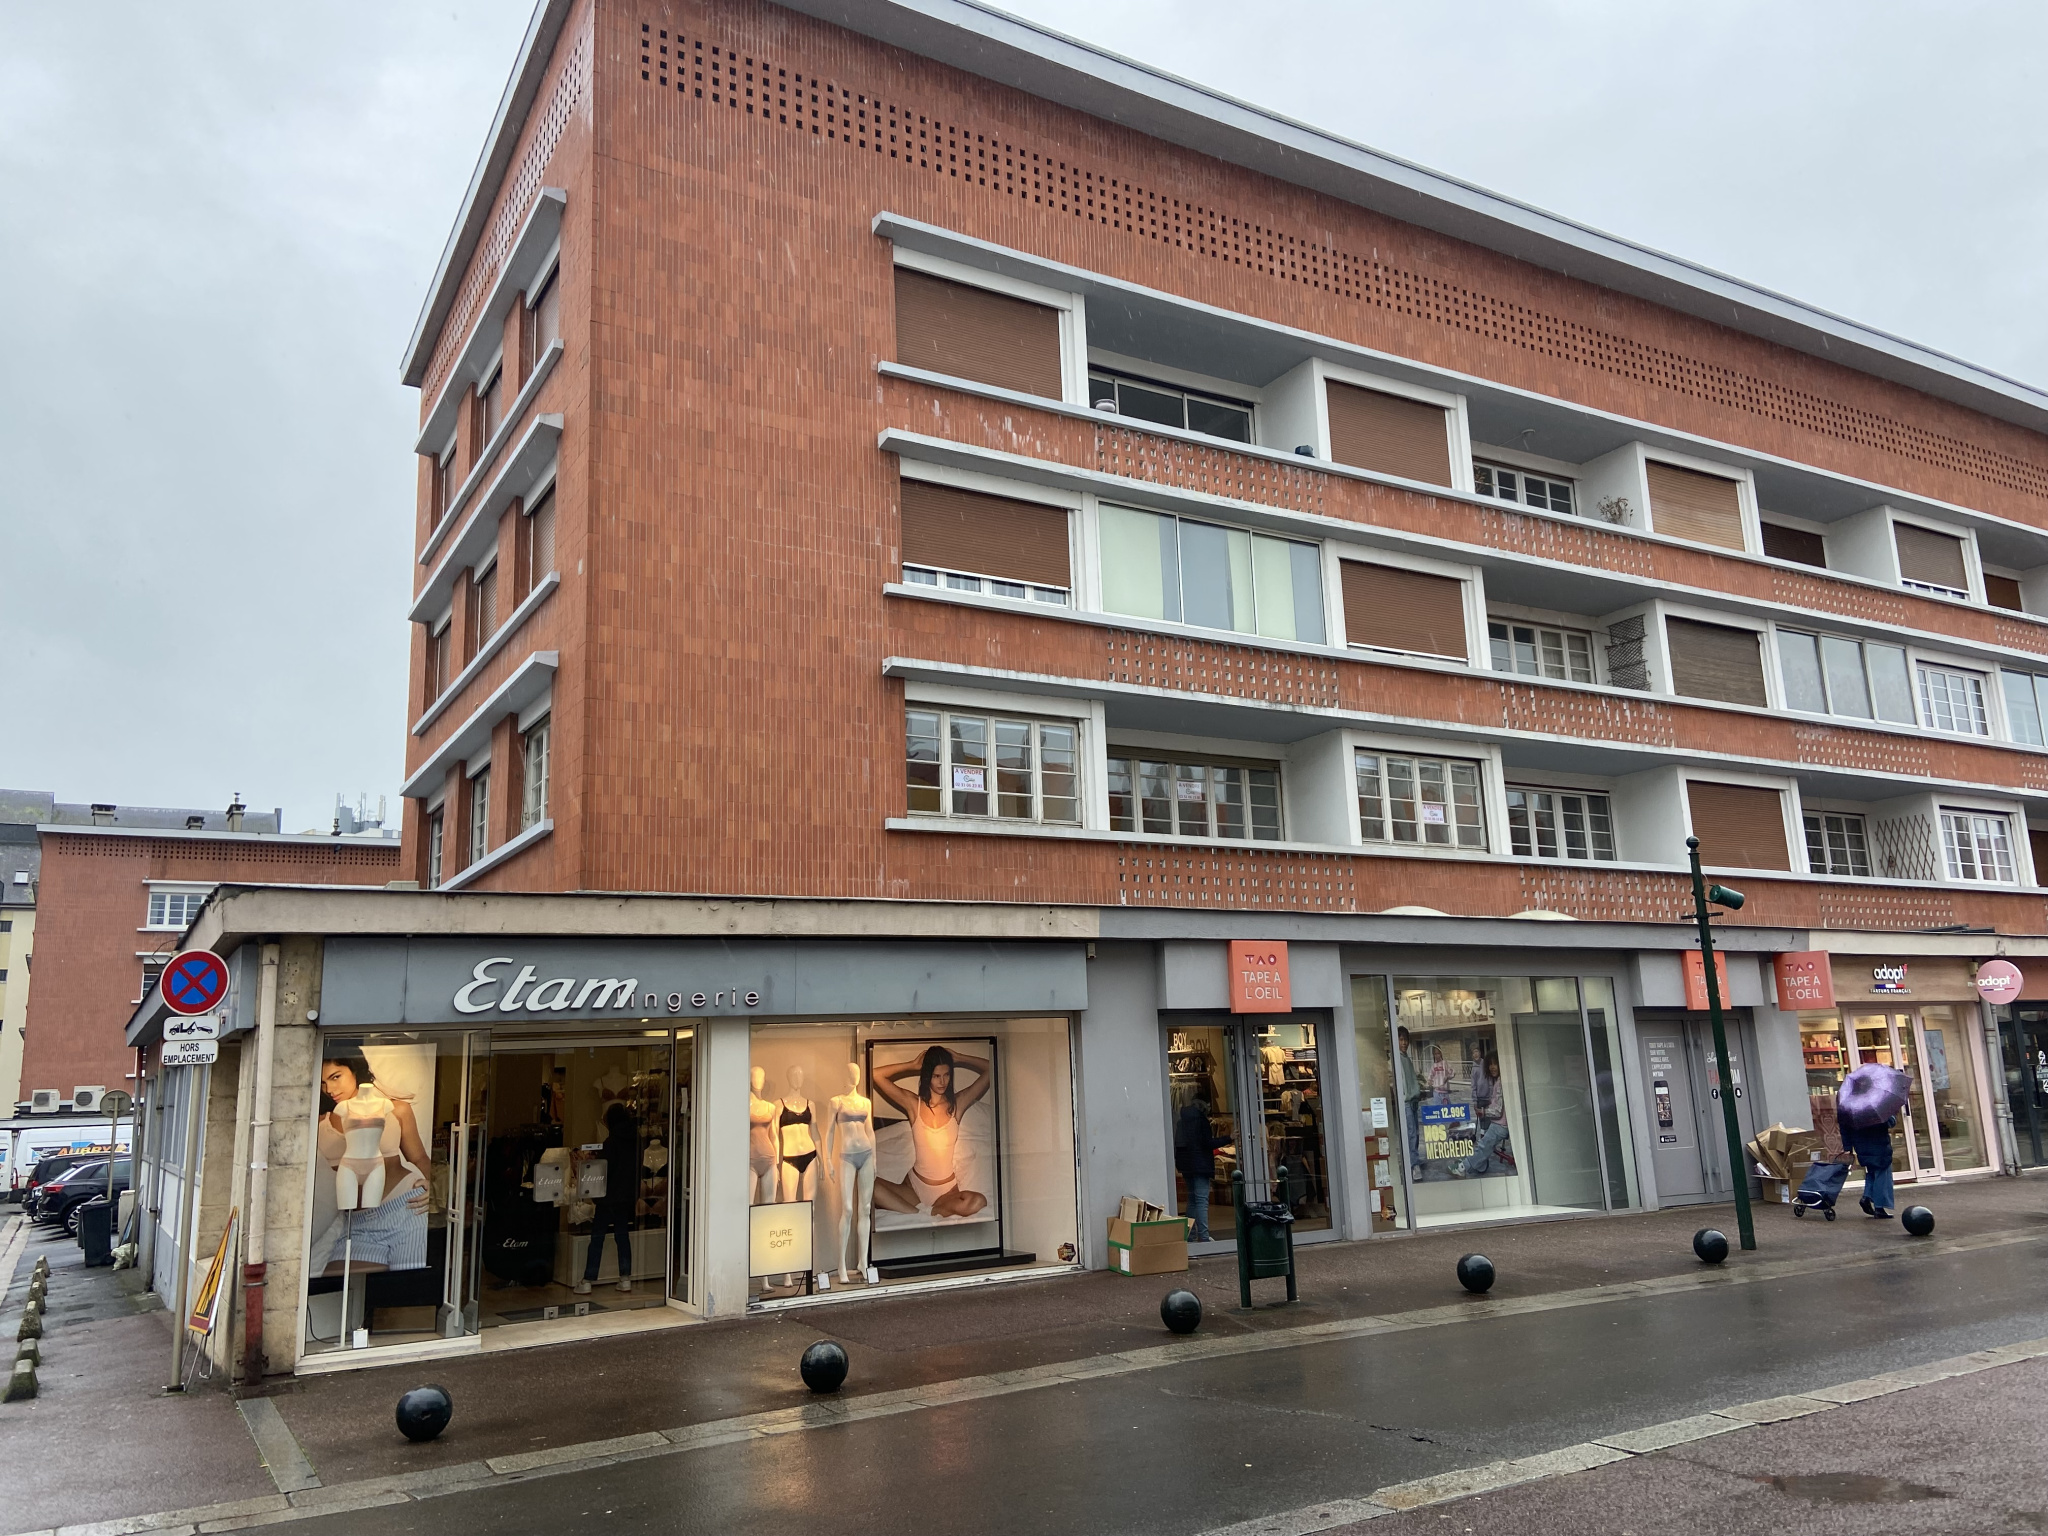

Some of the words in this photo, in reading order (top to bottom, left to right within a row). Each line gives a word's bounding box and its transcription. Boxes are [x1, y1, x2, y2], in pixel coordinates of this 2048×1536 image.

[1244, 954, 1277, 966] TAO
[1784, 962, 1815, 971] TAO
[1241, 971, 1271, 984] TAPE
[1782, 976, 1812, 988] TAPE
[453, 957, 639, 1014] Etam
[1396, 1000, 1432, 1016] APE
[1173, 1032, 1188, 1050] BOY
[180, 1043, 200, 1052] HORS
[163, 1053, 215, 1064] EMPLACEMENT
[1424, 1125, 1447, 1142] NOS
[1426, 1140, 1474, 1160] MERCREDIS
[538, 1178, 562, 1186] Etam
[770, 1228, 793, 1238] PURE
[503, 1238, 528, 1248] Etam
[770, 1239, 793, 1249] SOFT
